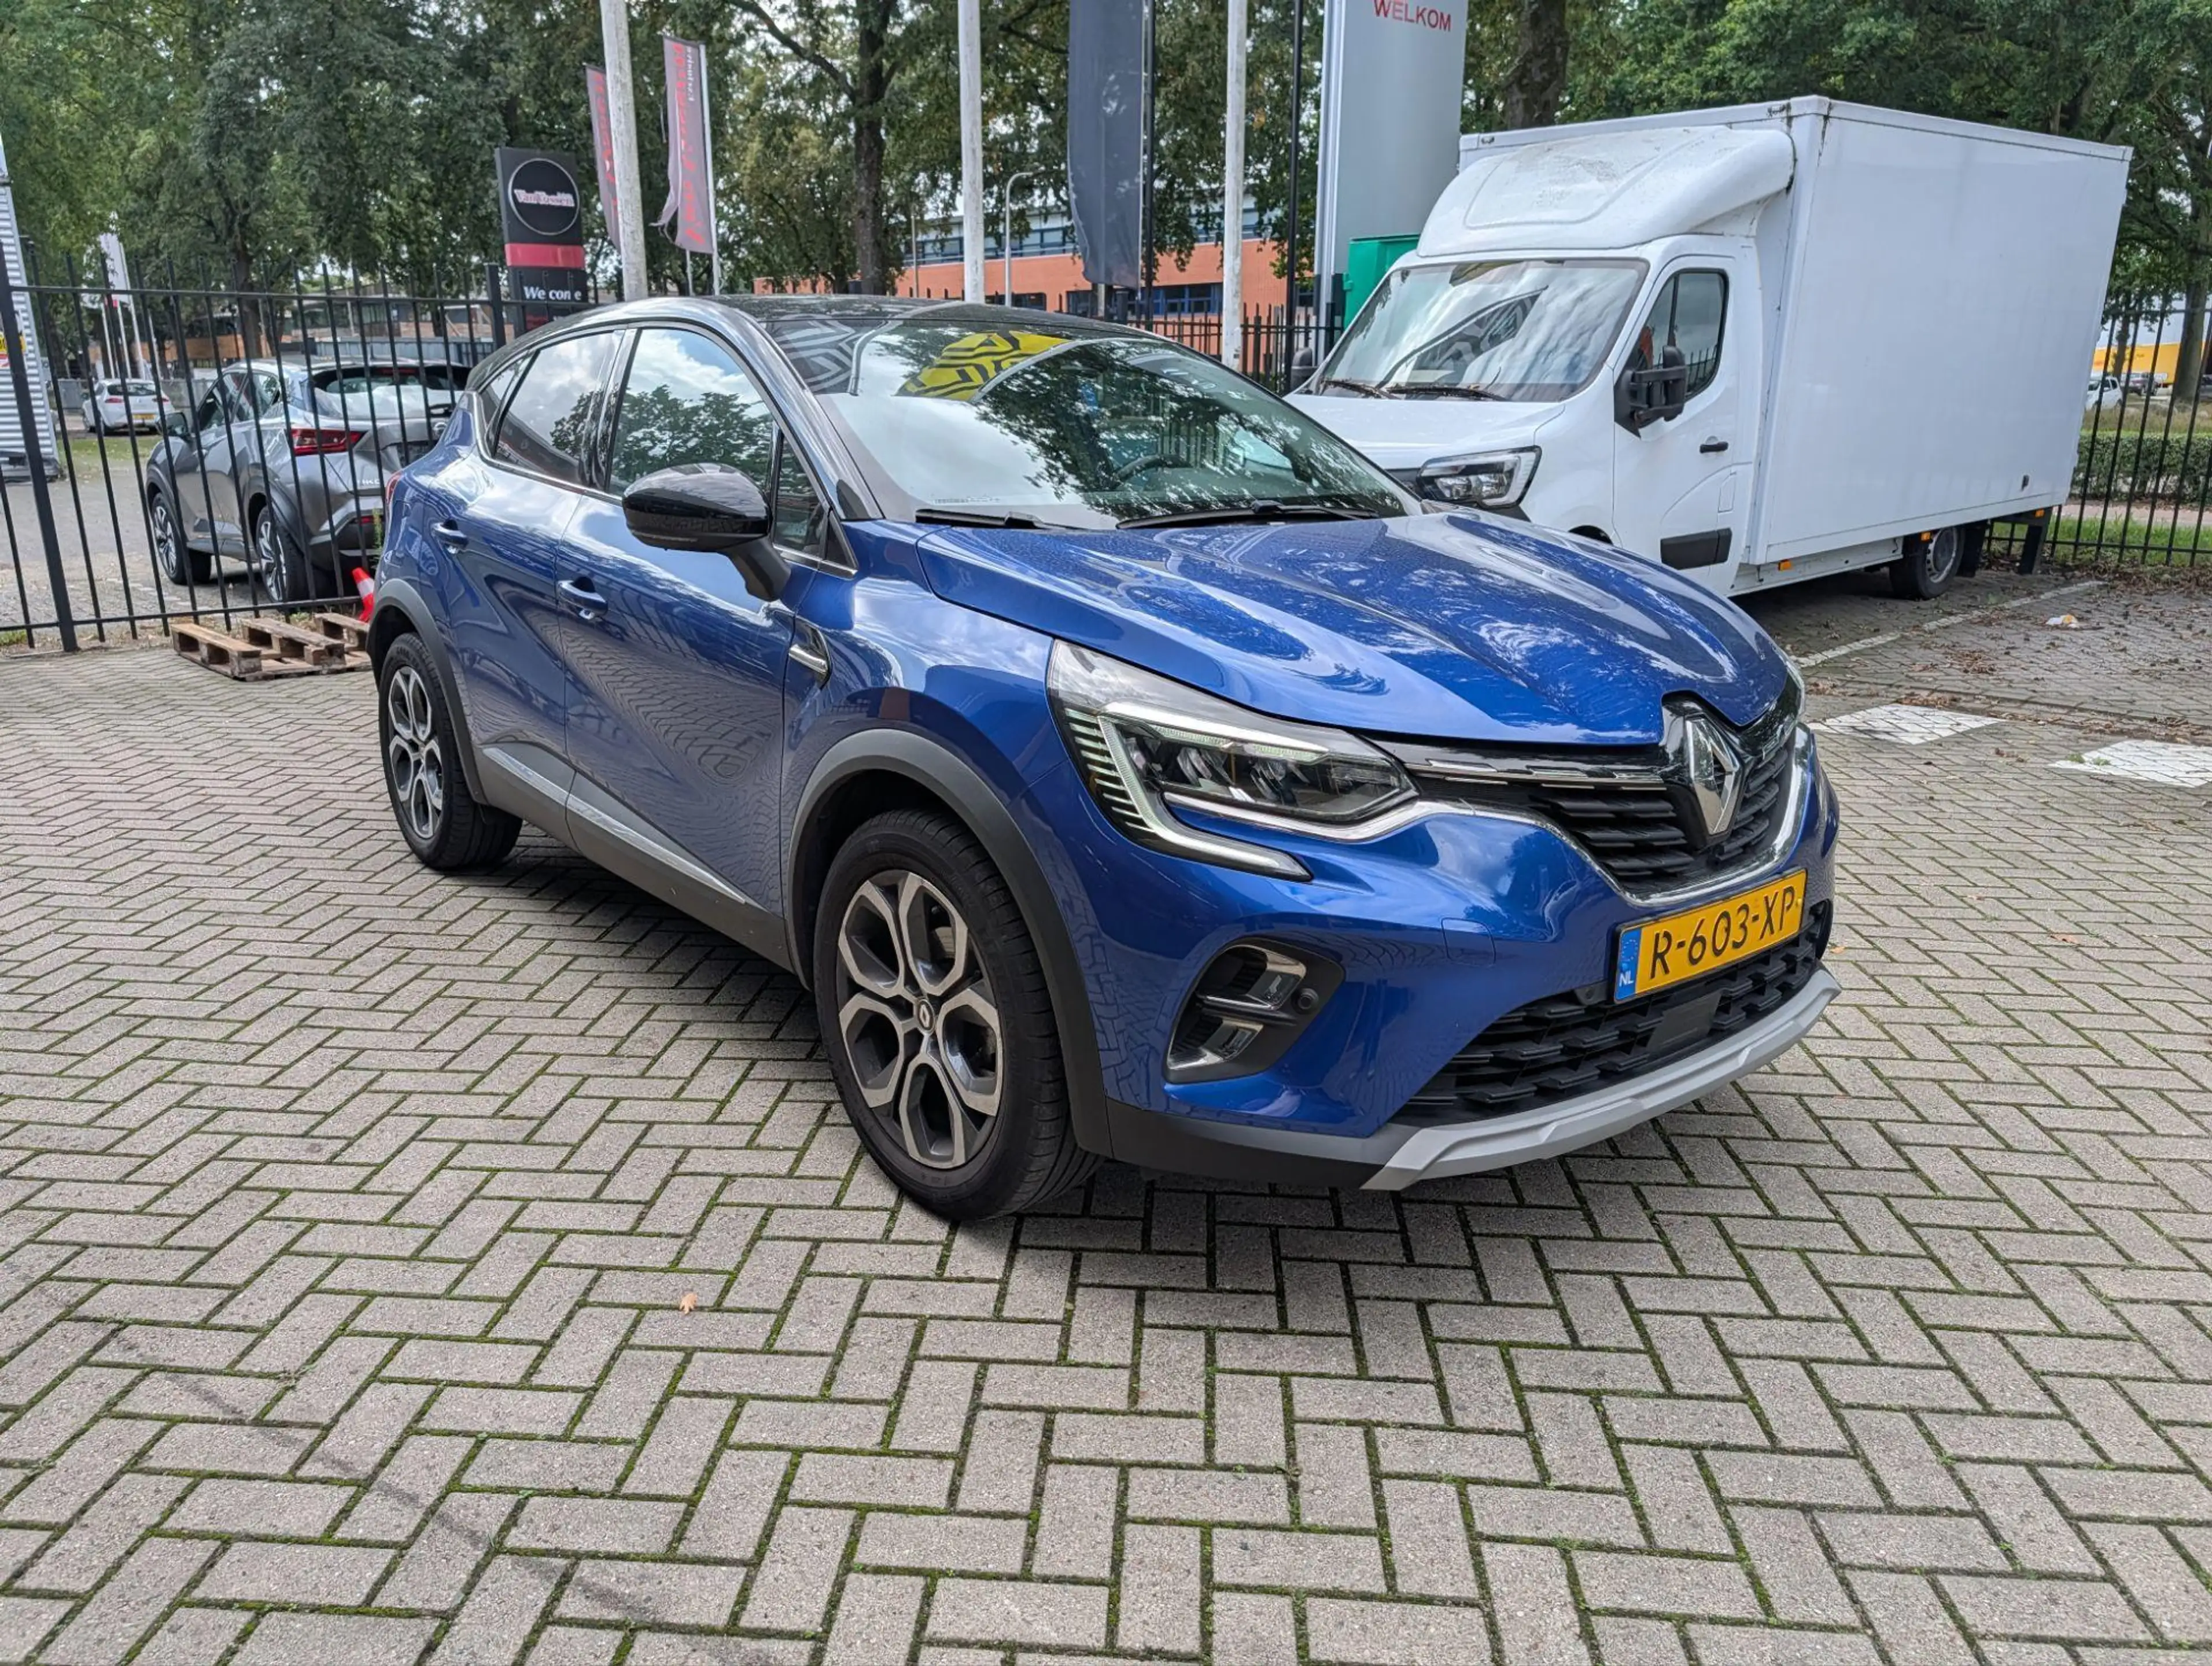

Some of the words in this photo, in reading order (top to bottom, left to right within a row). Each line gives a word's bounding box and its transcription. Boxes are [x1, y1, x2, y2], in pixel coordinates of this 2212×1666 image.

[1374, 0, 1451, 31] WELKOM
[1649, 886, 1795, 981] R-603-XP
[1619, 971, 1634, 987] NL
